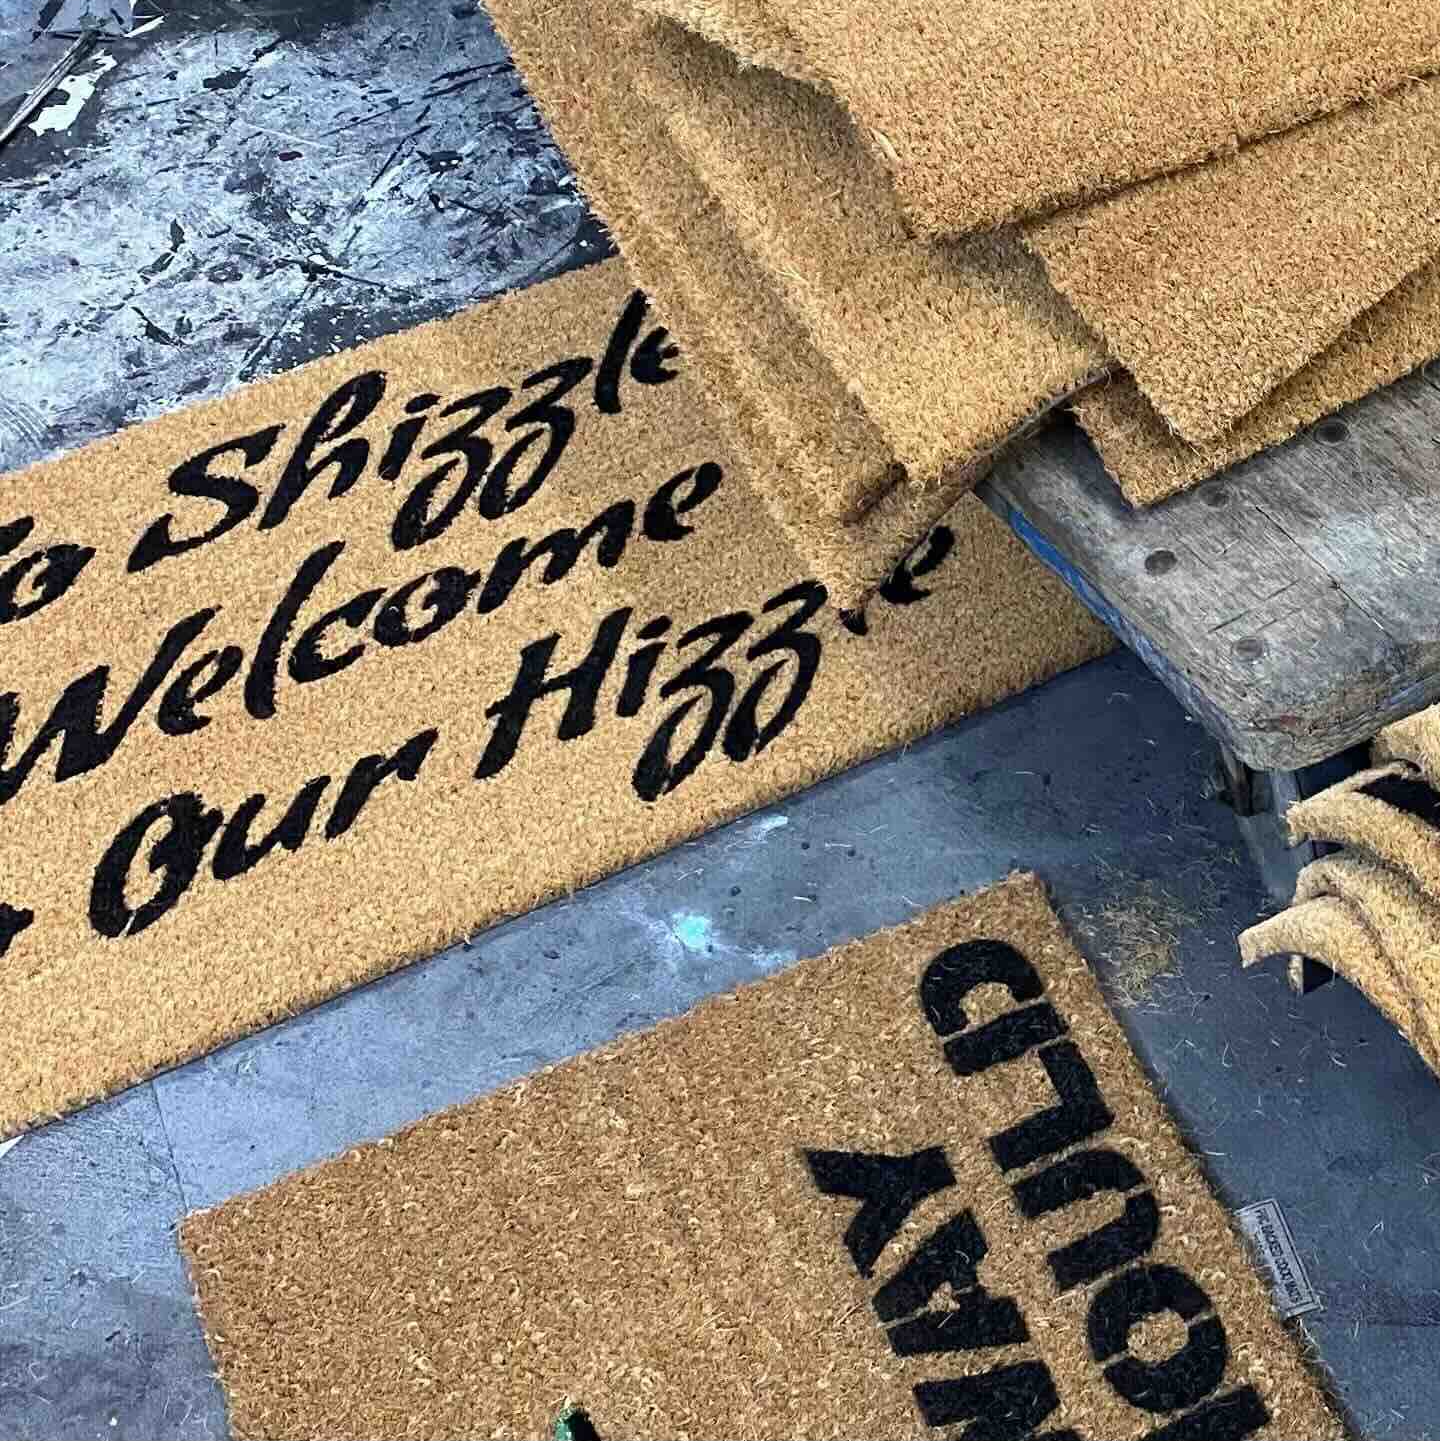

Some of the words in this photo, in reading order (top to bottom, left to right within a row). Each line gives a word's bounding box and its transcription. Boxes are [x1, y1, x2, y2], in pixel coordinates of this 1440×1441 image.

[0, 516, 96, 624] o
[88, 728, 438, 939] Our
[473, 524, 956, 804] Hizze
